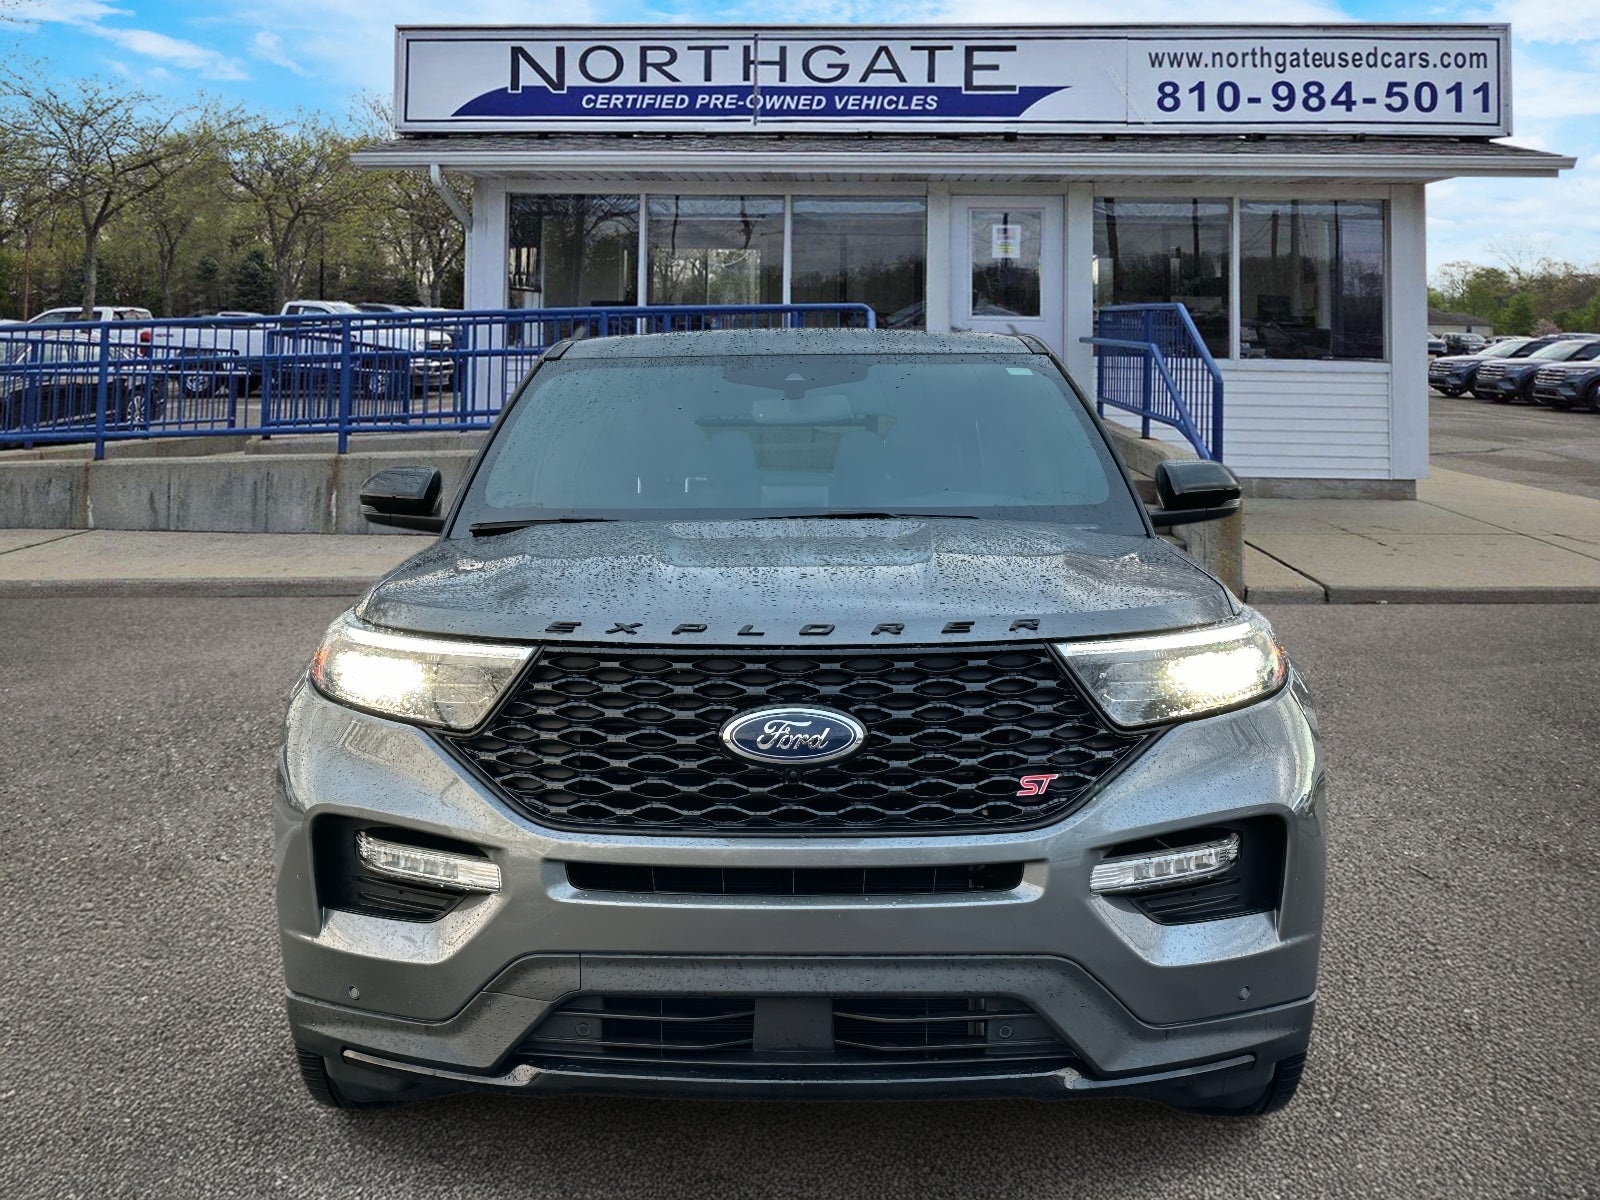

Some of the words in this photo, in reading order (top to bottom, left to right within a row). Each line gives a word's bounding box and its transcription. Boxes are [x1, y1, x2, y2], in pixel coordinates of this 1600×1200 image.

[509, 44, 1017, 92] NORTHGATE
[1148, 46, 1488, 73] www.northgateusedcars.com
[581, 94, 689, 110] CERTIFIED
[695, 94, 826, 110] PRE-OWNED
[834, 95, 938, 111] VEHICLES
[1156, 80, 1490, 113] 810-984-5011
[544, 618, 1040, 635] EXPLORER
[756, 719, 831, 750] Ford
[1016, 774, 1059, 796] ST
